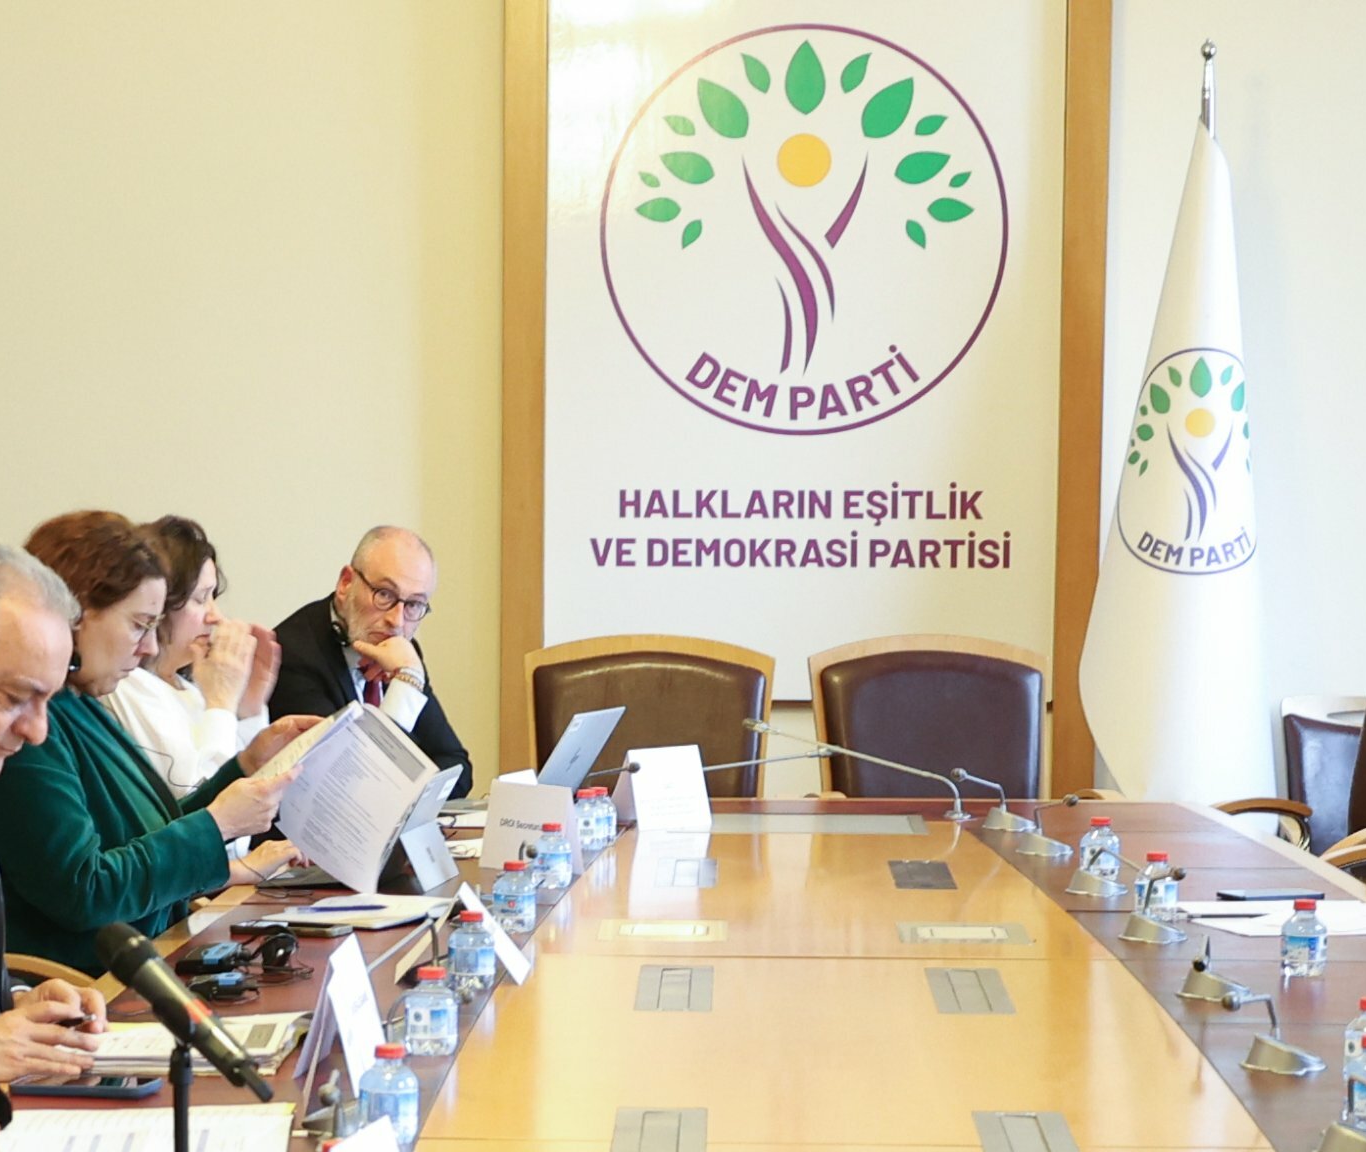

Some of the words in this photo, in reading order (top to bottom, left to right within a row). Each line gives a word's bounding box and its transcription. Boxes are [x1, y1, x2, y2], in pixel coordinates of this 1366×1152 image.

[685, 351, 779, 418] DEM
[789, 344, 920, 421] PARTİ
[619, 489, 832, 519] HALKLARIN
[843, 481, 984, 527] EŞİTLİK
[590, 537, 636, 567] VE
[646, 530, 858, 568] DEMOKRASİ
[868, 530, 1011, 569] PARTİSİ
[1137, 530, 1184, 566] DEM
[1189, 526, 1251, 567] PARTİ
